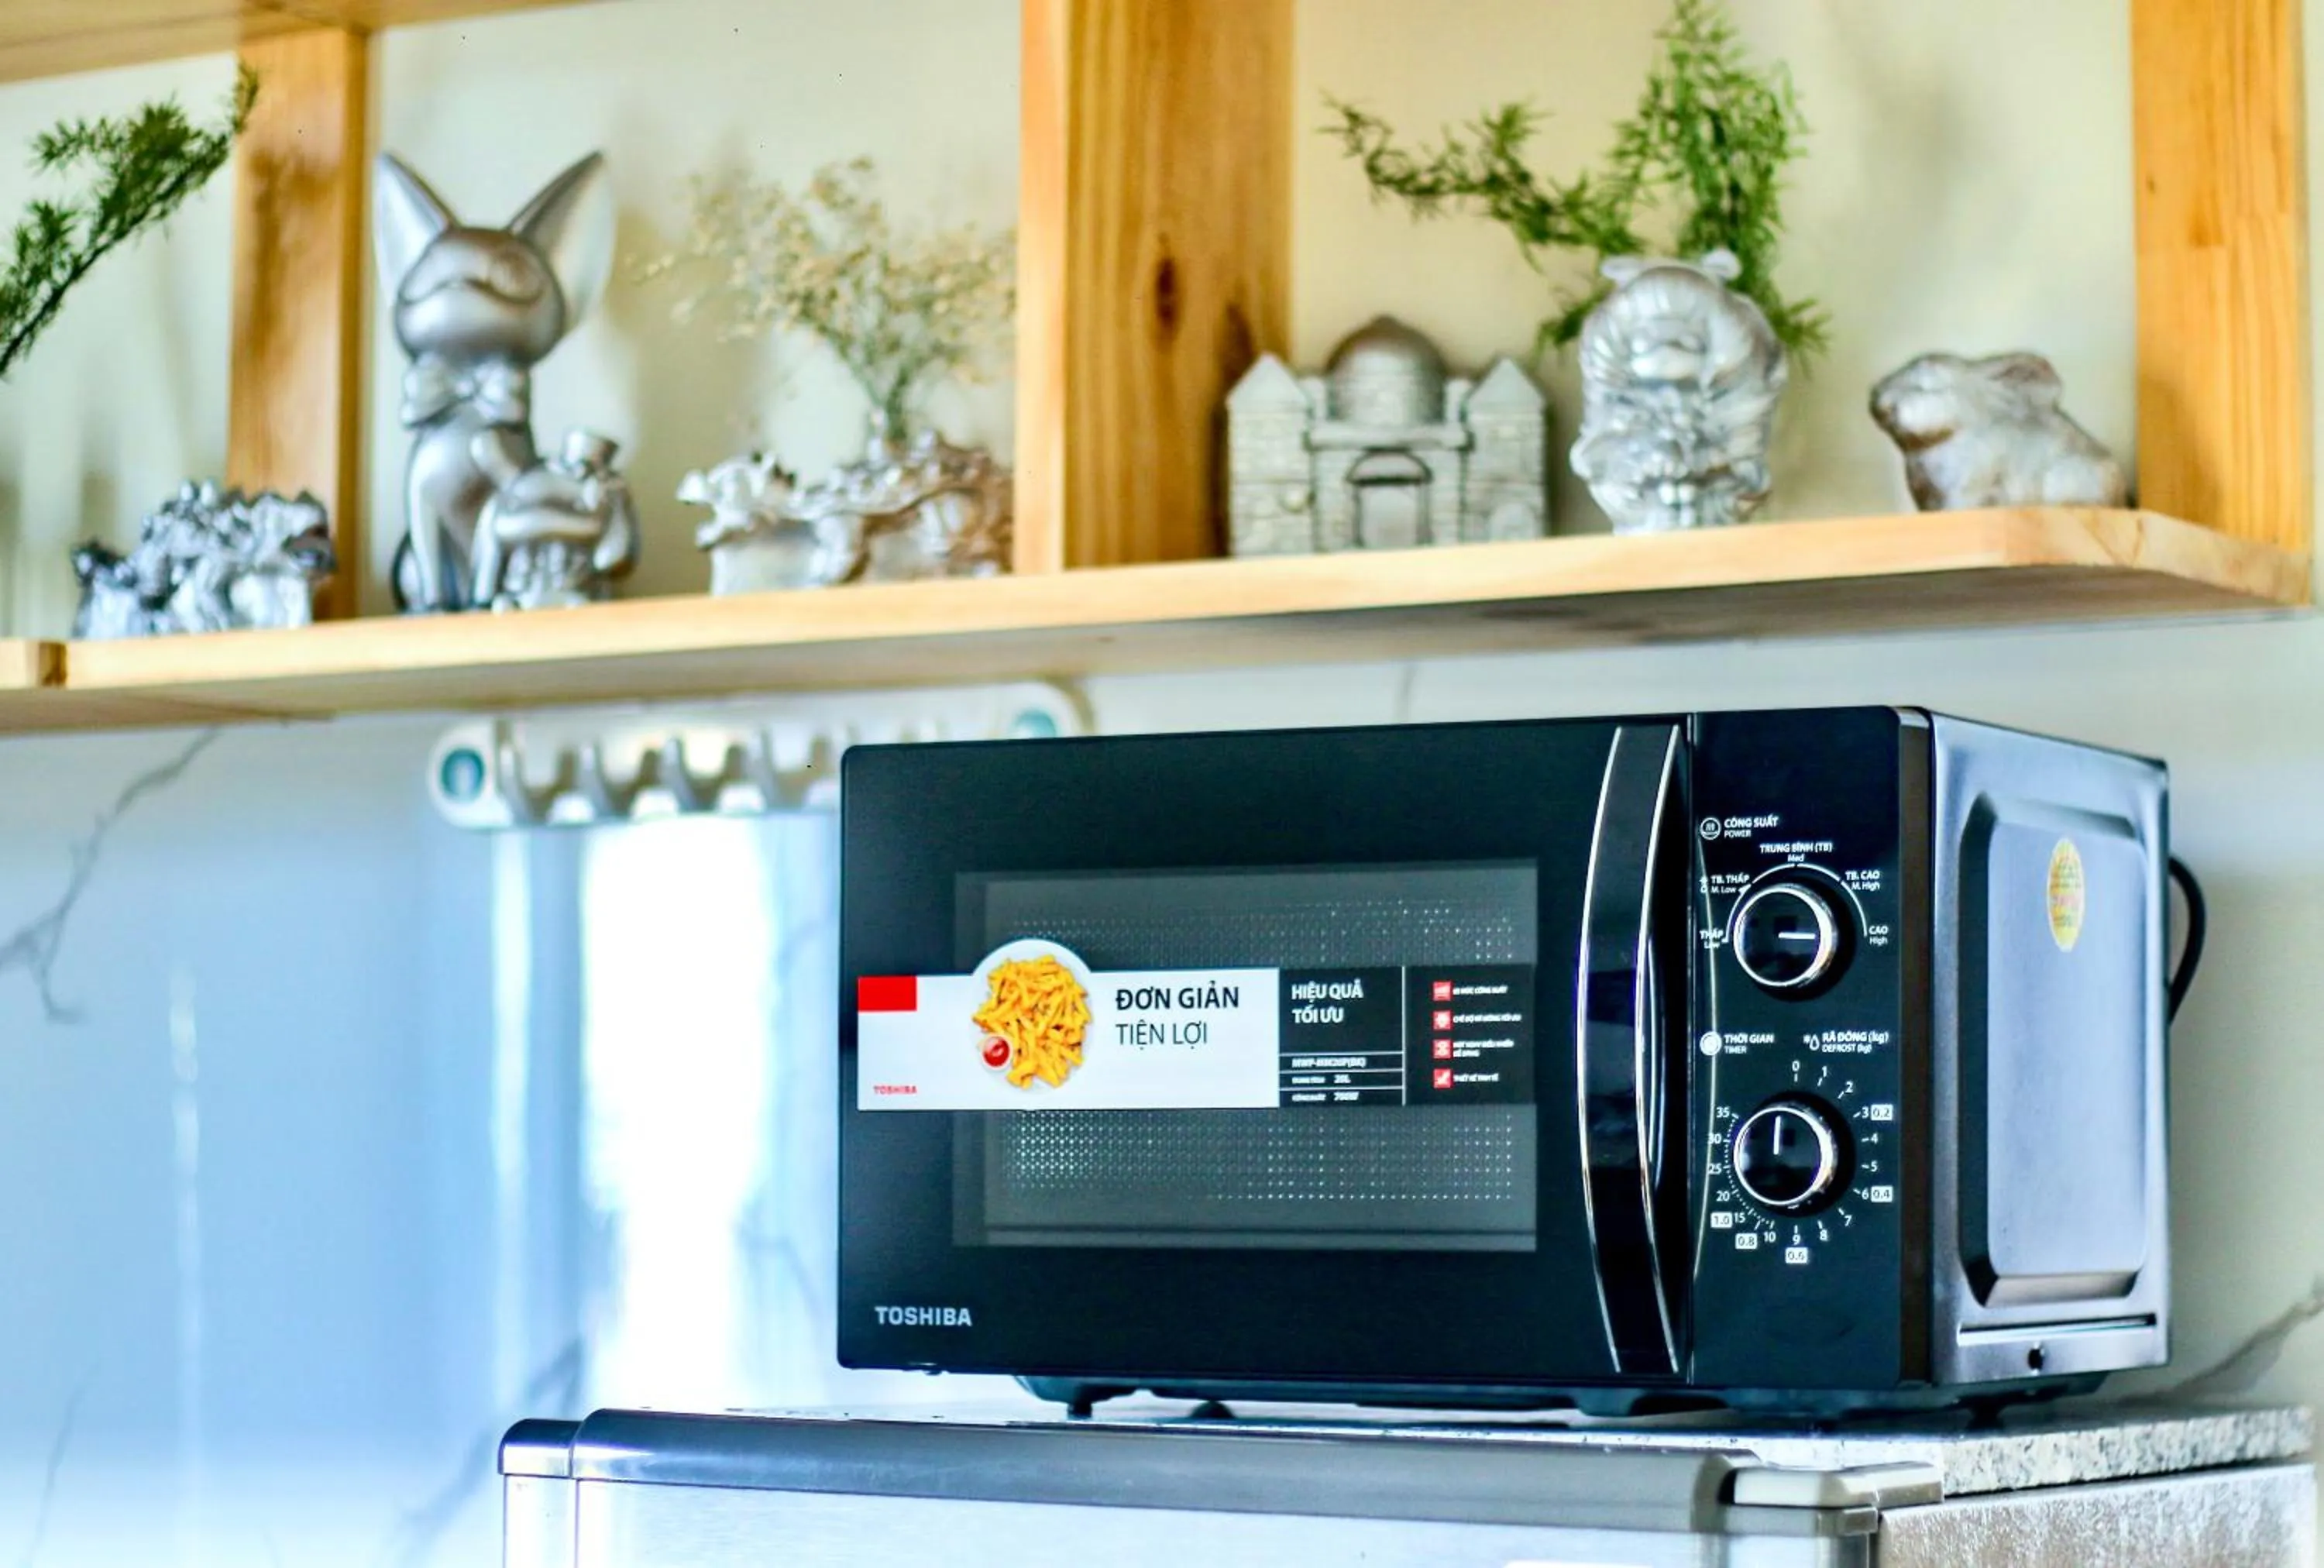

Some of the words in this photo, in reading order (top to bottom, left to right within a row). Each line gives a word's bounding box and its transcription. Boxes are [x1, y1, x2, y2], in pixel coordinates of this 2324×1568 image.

[1724, 817, 1752, 828] CÔNG
[1754, 813, 1779, 827] SUẤT
[1760, 843, 1790, 853] TRUNG
[1815, 842, 1833, 852] (TB)
[1787, 854, 1805, 862] Med
[1861, 869, 1880, 880] CAO
[1851, 882, 1861, 890] M.
[1862, 882, 1880, 891] High
[1868, 925, 1889, 935] CAO
[1869, 936, 1888, 946] High
[1116, 986, 1171, 1010] ĐƠN
[1178, 980, 1239, 1009] GIẢN
[1291, 981, 1327, 1003] HIỆU
[1329, 978, 1363, 1000] QUẢ
[1292, 1005, 1318, 1023] TỐI
[1320, 1006, 1344, 1023] ƯU
[1116, 1019, 1164, 1050] TIỆN
[1172, 1020, 1207, 1049] LỢI
[1749, 1033, 1775, 1044] GIAN
[1868, 1030, 1889, 1044] (kg)
[1822, 1044, 1856, 1053] DEFROST
[1792, 1061, 1800, 1071] 0
[1822, 1066, 1827, 1077] 1
[873, 1085, 917, 1095] TOSHIBA
[1845, 1081, 1853, 1092] 2
[1716, 1107, 1730, 1118] 35
[1862, 1106, 1868, 1117] 3
[1873, 1108, 1890, 1119] 0.2
[1870, 1133, 1879, 1143] 4
[1708, 1164, 1722, 1174] 25
[1871, 1161, 1879, 1172] 5
[1716, 1191, 1730, 1201] 20
[1862, 1189, 1868, 1200] 6
[1873, 1188, 1890, 1200] 0.4
[1714, 1215, 1730, 1226] 1.0
[1734, 1212, 1746, 1223] 15
[1844, 1215, 1852, 1226] 7
[1738, 1235, 1755, 1246] 0.8
[1763, 1231, 1776, 1243] 10
[1792, 1233, 1801, 1246] 9
[1820, 1229, 1828, 1241] 8
[1787, 1250, 1806, 1261] 0.6
[875, 1305, 973, 1327] TOSHIBA
